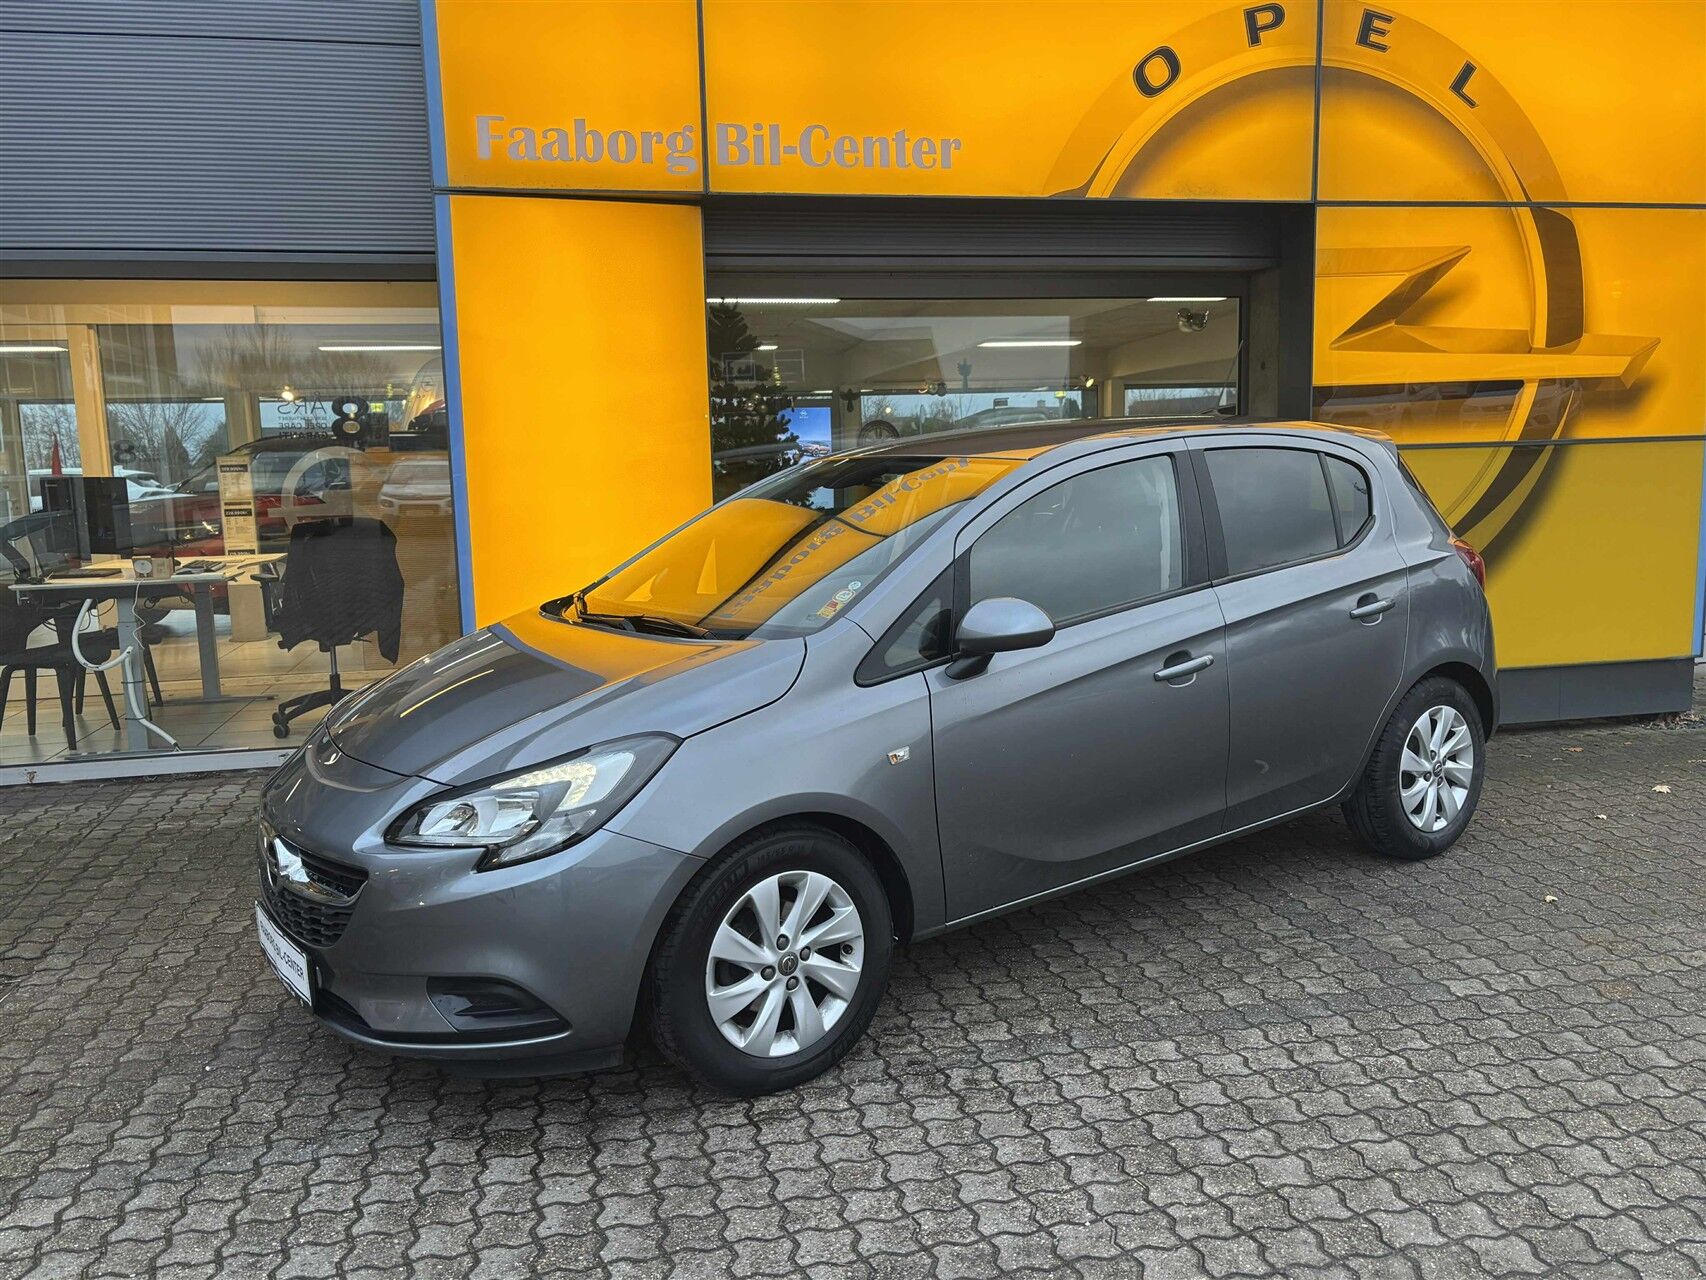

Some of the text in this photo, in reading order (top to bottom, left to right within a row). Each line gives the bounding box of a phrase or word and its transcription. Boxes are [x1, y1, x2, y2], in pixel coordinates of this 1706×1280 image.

[1133, 2, 1480, 109] OPEL
[475, 115, 962, 176] Faaborg Bil-Center
